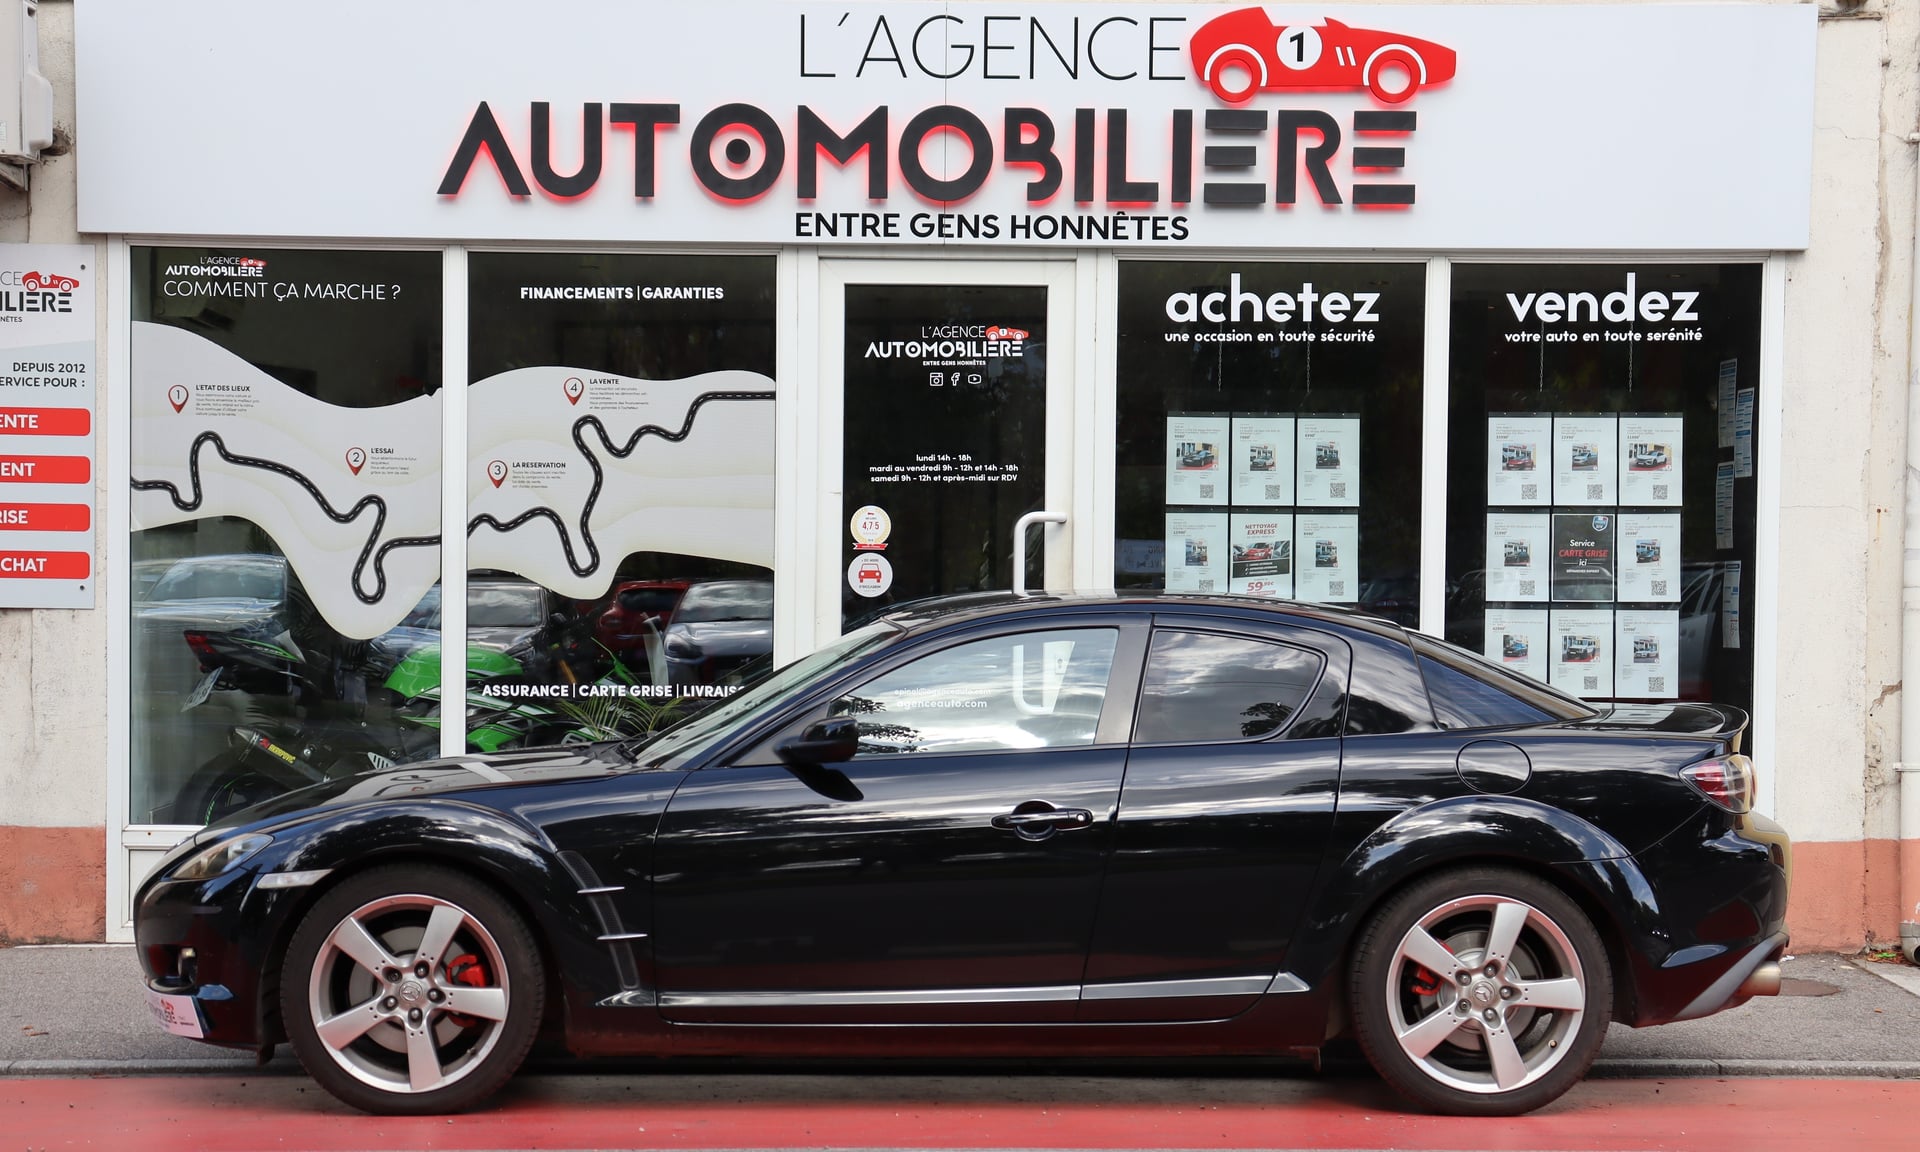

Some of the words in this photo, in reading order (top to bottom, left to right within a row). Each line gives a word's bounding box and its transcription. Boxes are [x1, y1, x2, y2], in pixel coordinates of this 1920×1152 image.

[800, 12, 1187, 82] L'AGENCE
[436, 100, 1418, 205] AUTOMOBILIERE
[795, 212, 900, 238] ENTRE
[909, 212, 1000, 240] GENS
[1010, 209, 1190, 241] HONNÊTES
[200, 256, 240, 265] L'AGENCE
[165, 265, 263, 277] AUTOMOBILIERE
[164, 280, 269, 297] COMMENT
[273, 282, 299, 302] ÇA
[304, 283, 386, 300] MARCHE
[392, 284, 401, 300] ?
[520, 287, 634, 299] FINANCEMENTS
[642, 287, 724, 299] GARANTIES
[1165, 272, 1381, 323] achetez
[1505, 271, 1700, 323] vendez
[921, 325, 986, 338] L'AGENCE
[1165, 332, 1190, 342] une
[1195, 329, 1253, 342] occasion
[1257, 332, 1274, 342] en
[1278, 330, 1316, 342] toute
[1320, 328, 1376, 342] sécurité
[1505, 331, 1541, 342] votre
[1546, 330, 1578, 342] auto
[1583, 332, 1599, 342] en
[1604, 330, 1642, 342] toute
[1646, 328, 1703, 342] serénité
[864, 340, 1023, 358] AUTOMOBILIERE
[13, 362, 55, 373] DEPUIS
[58, 363, 86, 373] 2012
[43, 377, 78, 387] POUR
[570, 383, 577, 392] 4
[352, 452, 360, 462] 2
[916, 454, 936, 462] lundi
[937, 454, 951, 462] 14h
[958, 454, 972, 462] 18h
[494, 465, 501, 475] 3
[869, 464, 893, 472] mardi
[906, 464, 941, 472] vendredi
[870, 474, 900, 482] samedi
[942, 474, 986, 483] après-midi
[1569, 539, 1596, 547] Service
[1558, 549, 1584, 557] CARTE
[1585, 549, 1609, 557] GRISE
[1579, 558, 1588, 566] ici
[482, 684, 569, 697] ASSURANCE
[579, 684, 626, 697] CARTE
[629, 685, 673, 697] GRISE
[896, 699, 988, 710] agenceauto.com
